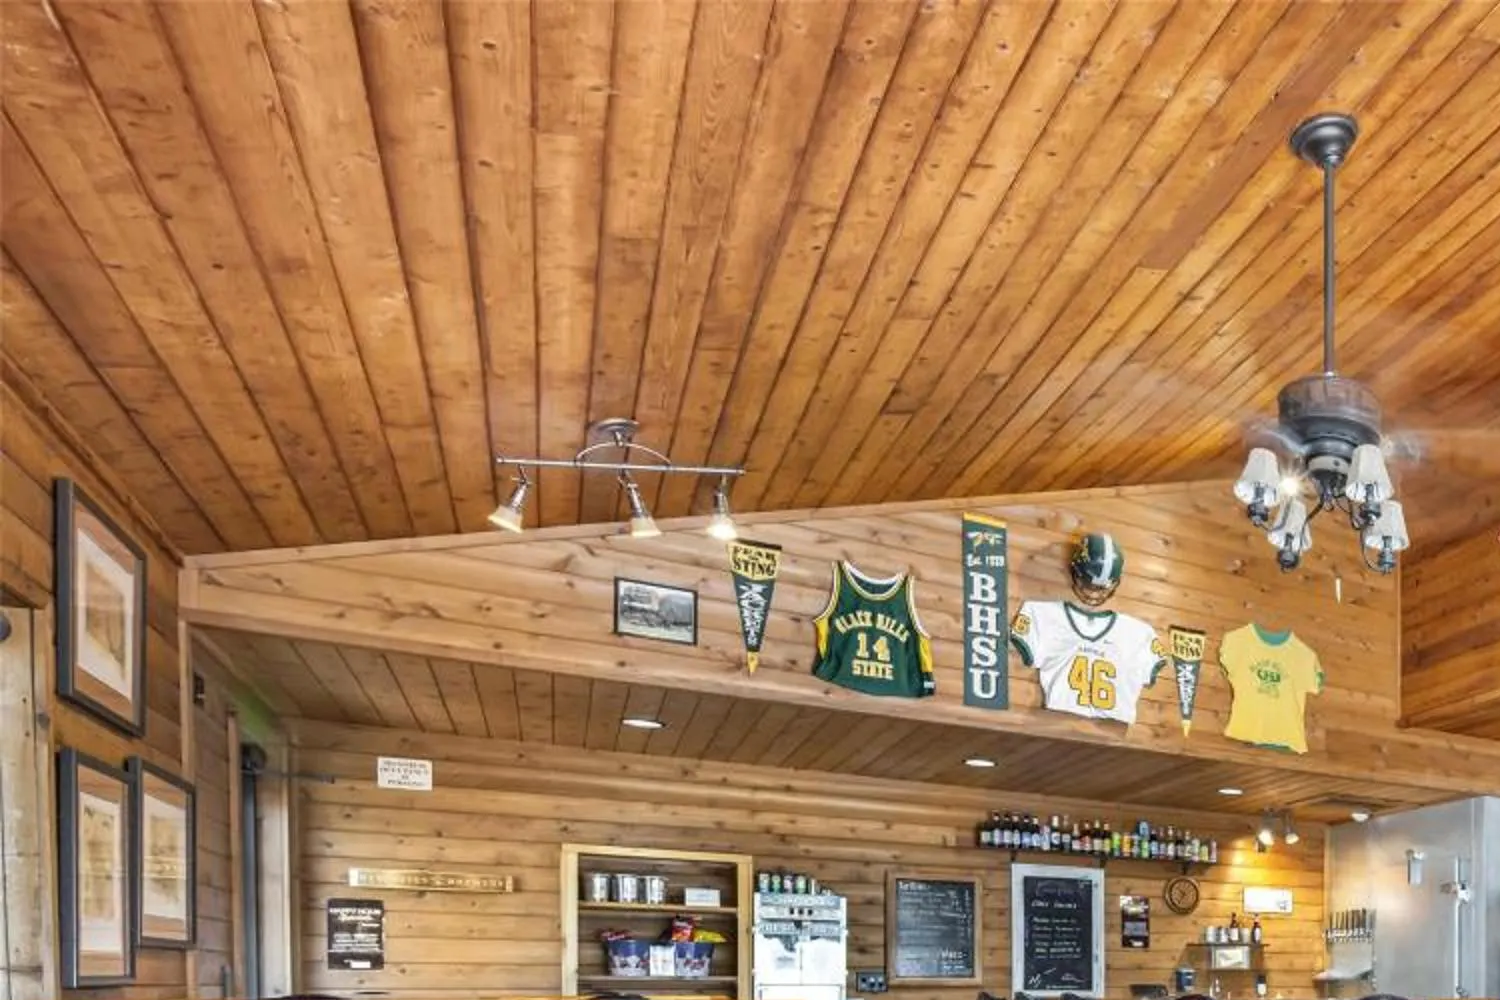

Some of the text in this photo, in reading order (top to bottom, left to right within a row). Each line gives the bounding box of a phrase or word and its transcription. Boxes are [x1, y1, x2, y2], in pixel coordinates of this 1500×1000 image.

[733, 559, 776, 578] STING
[834, 610, 911, 643] BLACK HILLS
[967, 571, 1001, 700] BHSU
[856, 631, 891, 662] 14
[851, 659, 895, 681] STATE
[1067, 655, 1117, 711] 46
